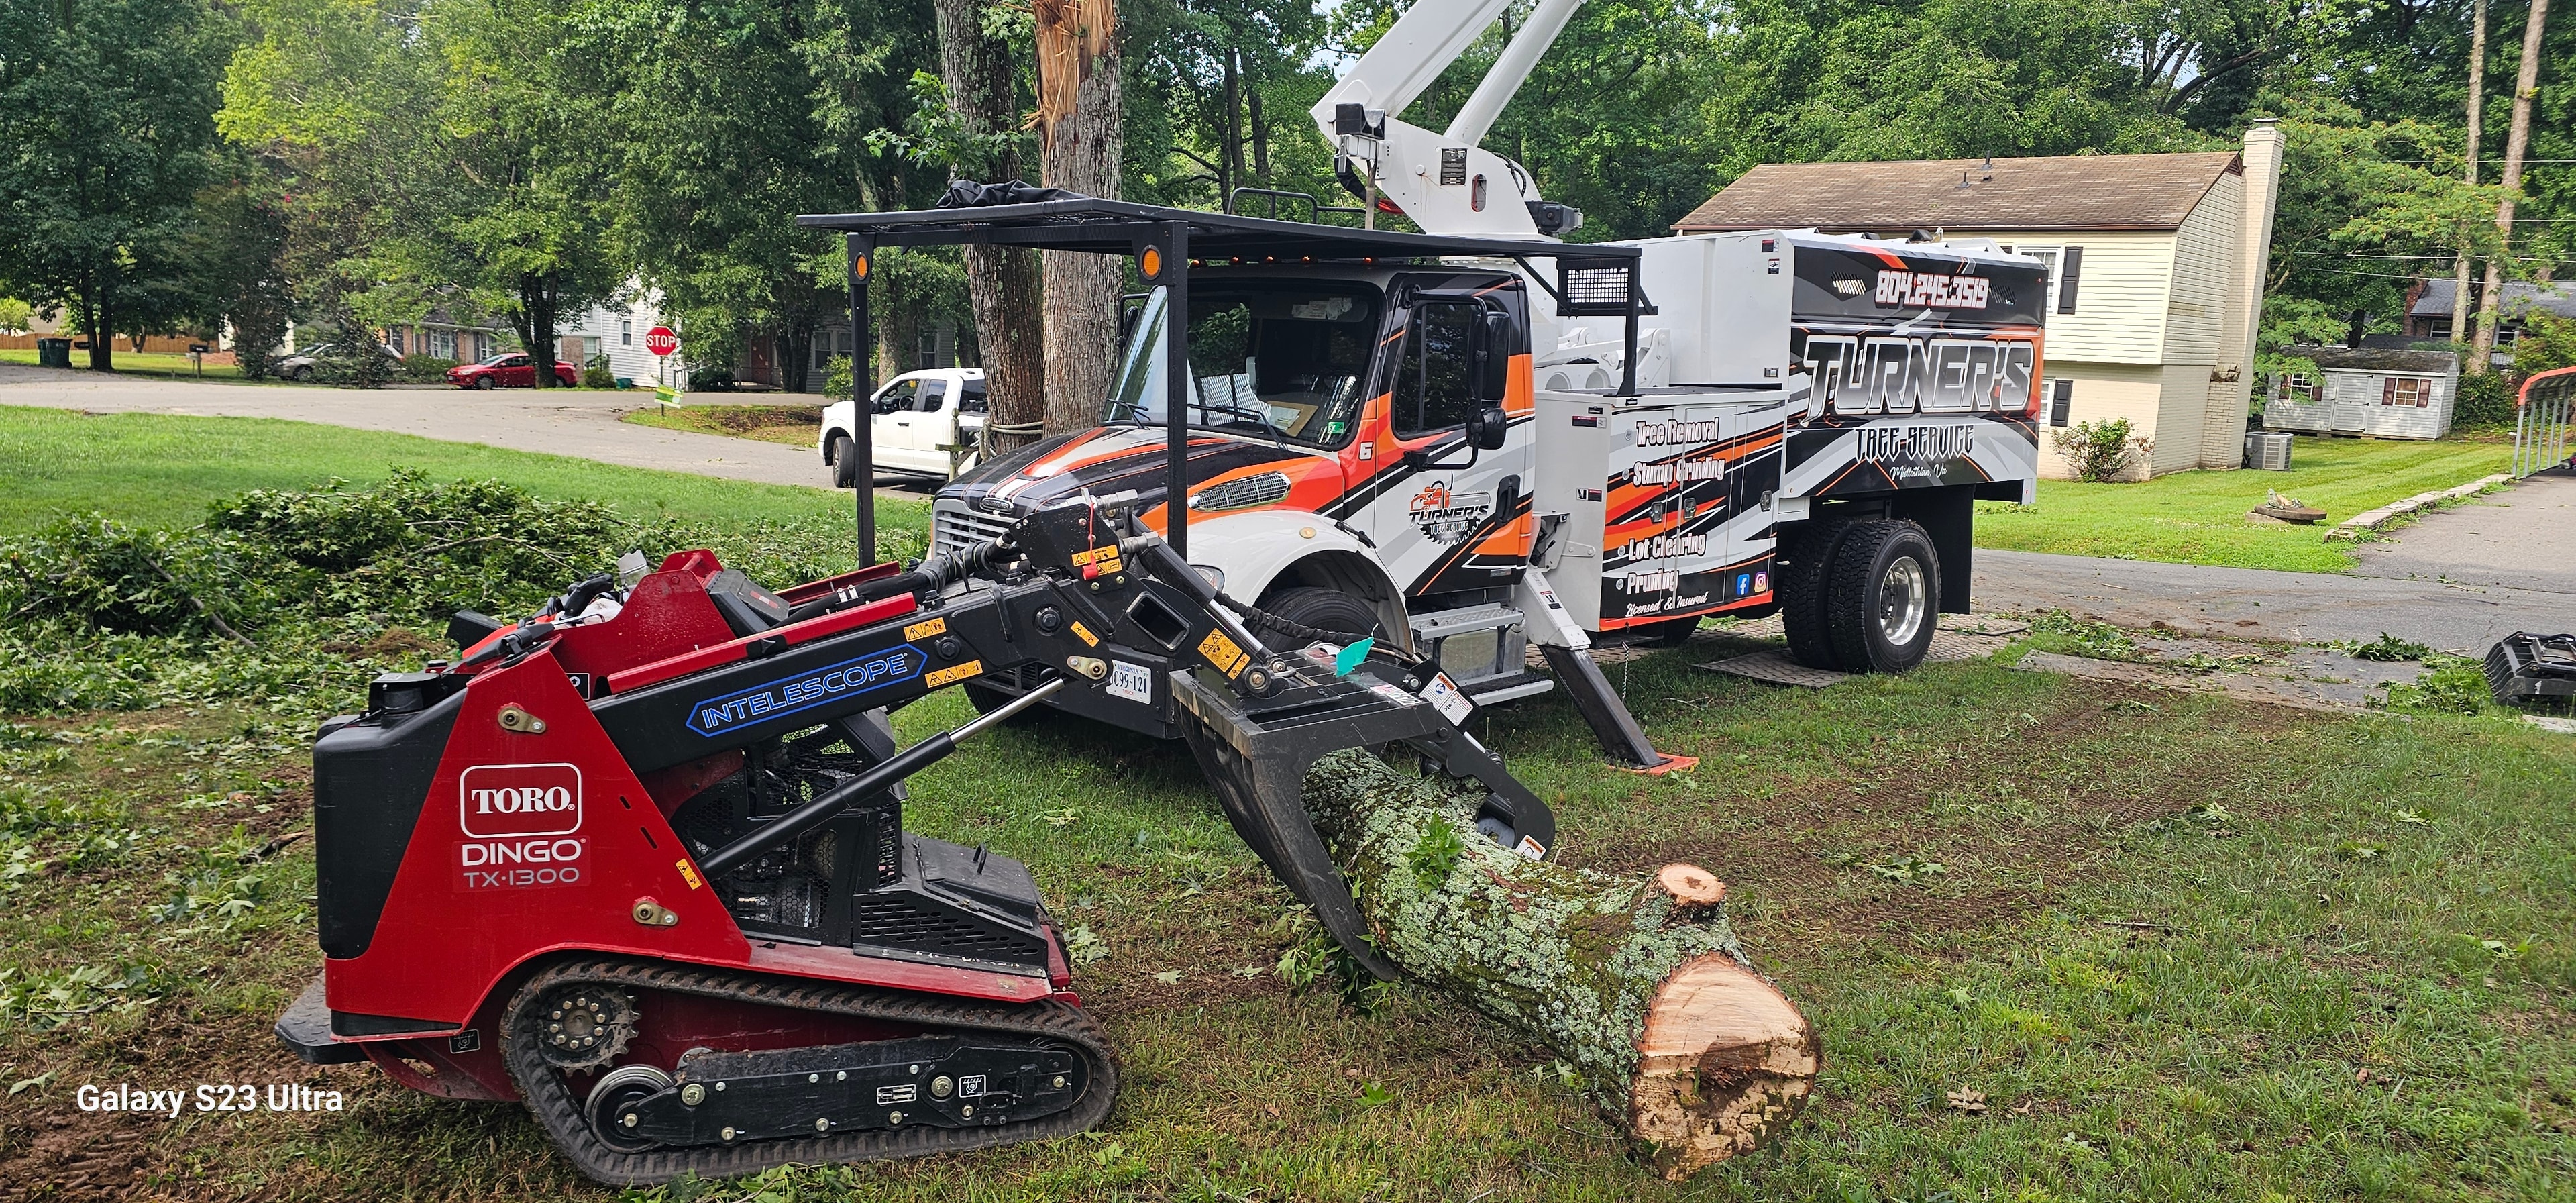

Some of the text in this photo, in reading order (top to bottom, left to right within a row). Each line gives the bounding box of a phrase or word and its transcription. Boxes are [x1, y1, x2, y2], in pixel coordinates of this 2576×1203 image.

[1875, 270, 1989, 309] 804.245.3519
[647, 335, 675, 347] STOP
[1802, 335, 2034, 427] TURNER'S
[1637, 417, 1719, 446] Tree Removal
[1855, 423, 1974, 464] TREE SERVICE
[1359, 441, 1374, 460] 6
[1633, 458, 1725, 486] Stump Grinding
[1409, 505, 1489, 529] TURNER'S
[1430, 521, 1469, 535] TREE SERVICE
[1629, 533, 1707, 561] Lot Clearing
[1627, 569, 1678, 594] Pruning
[1625, 591, 1709, 617] Licensed & Insured
[1117, 664, 1139, 674] VIRGINIA
[701, 653, 907, 729] INTELESCOPE
[1112, 671, 1147, 694] C99-121
